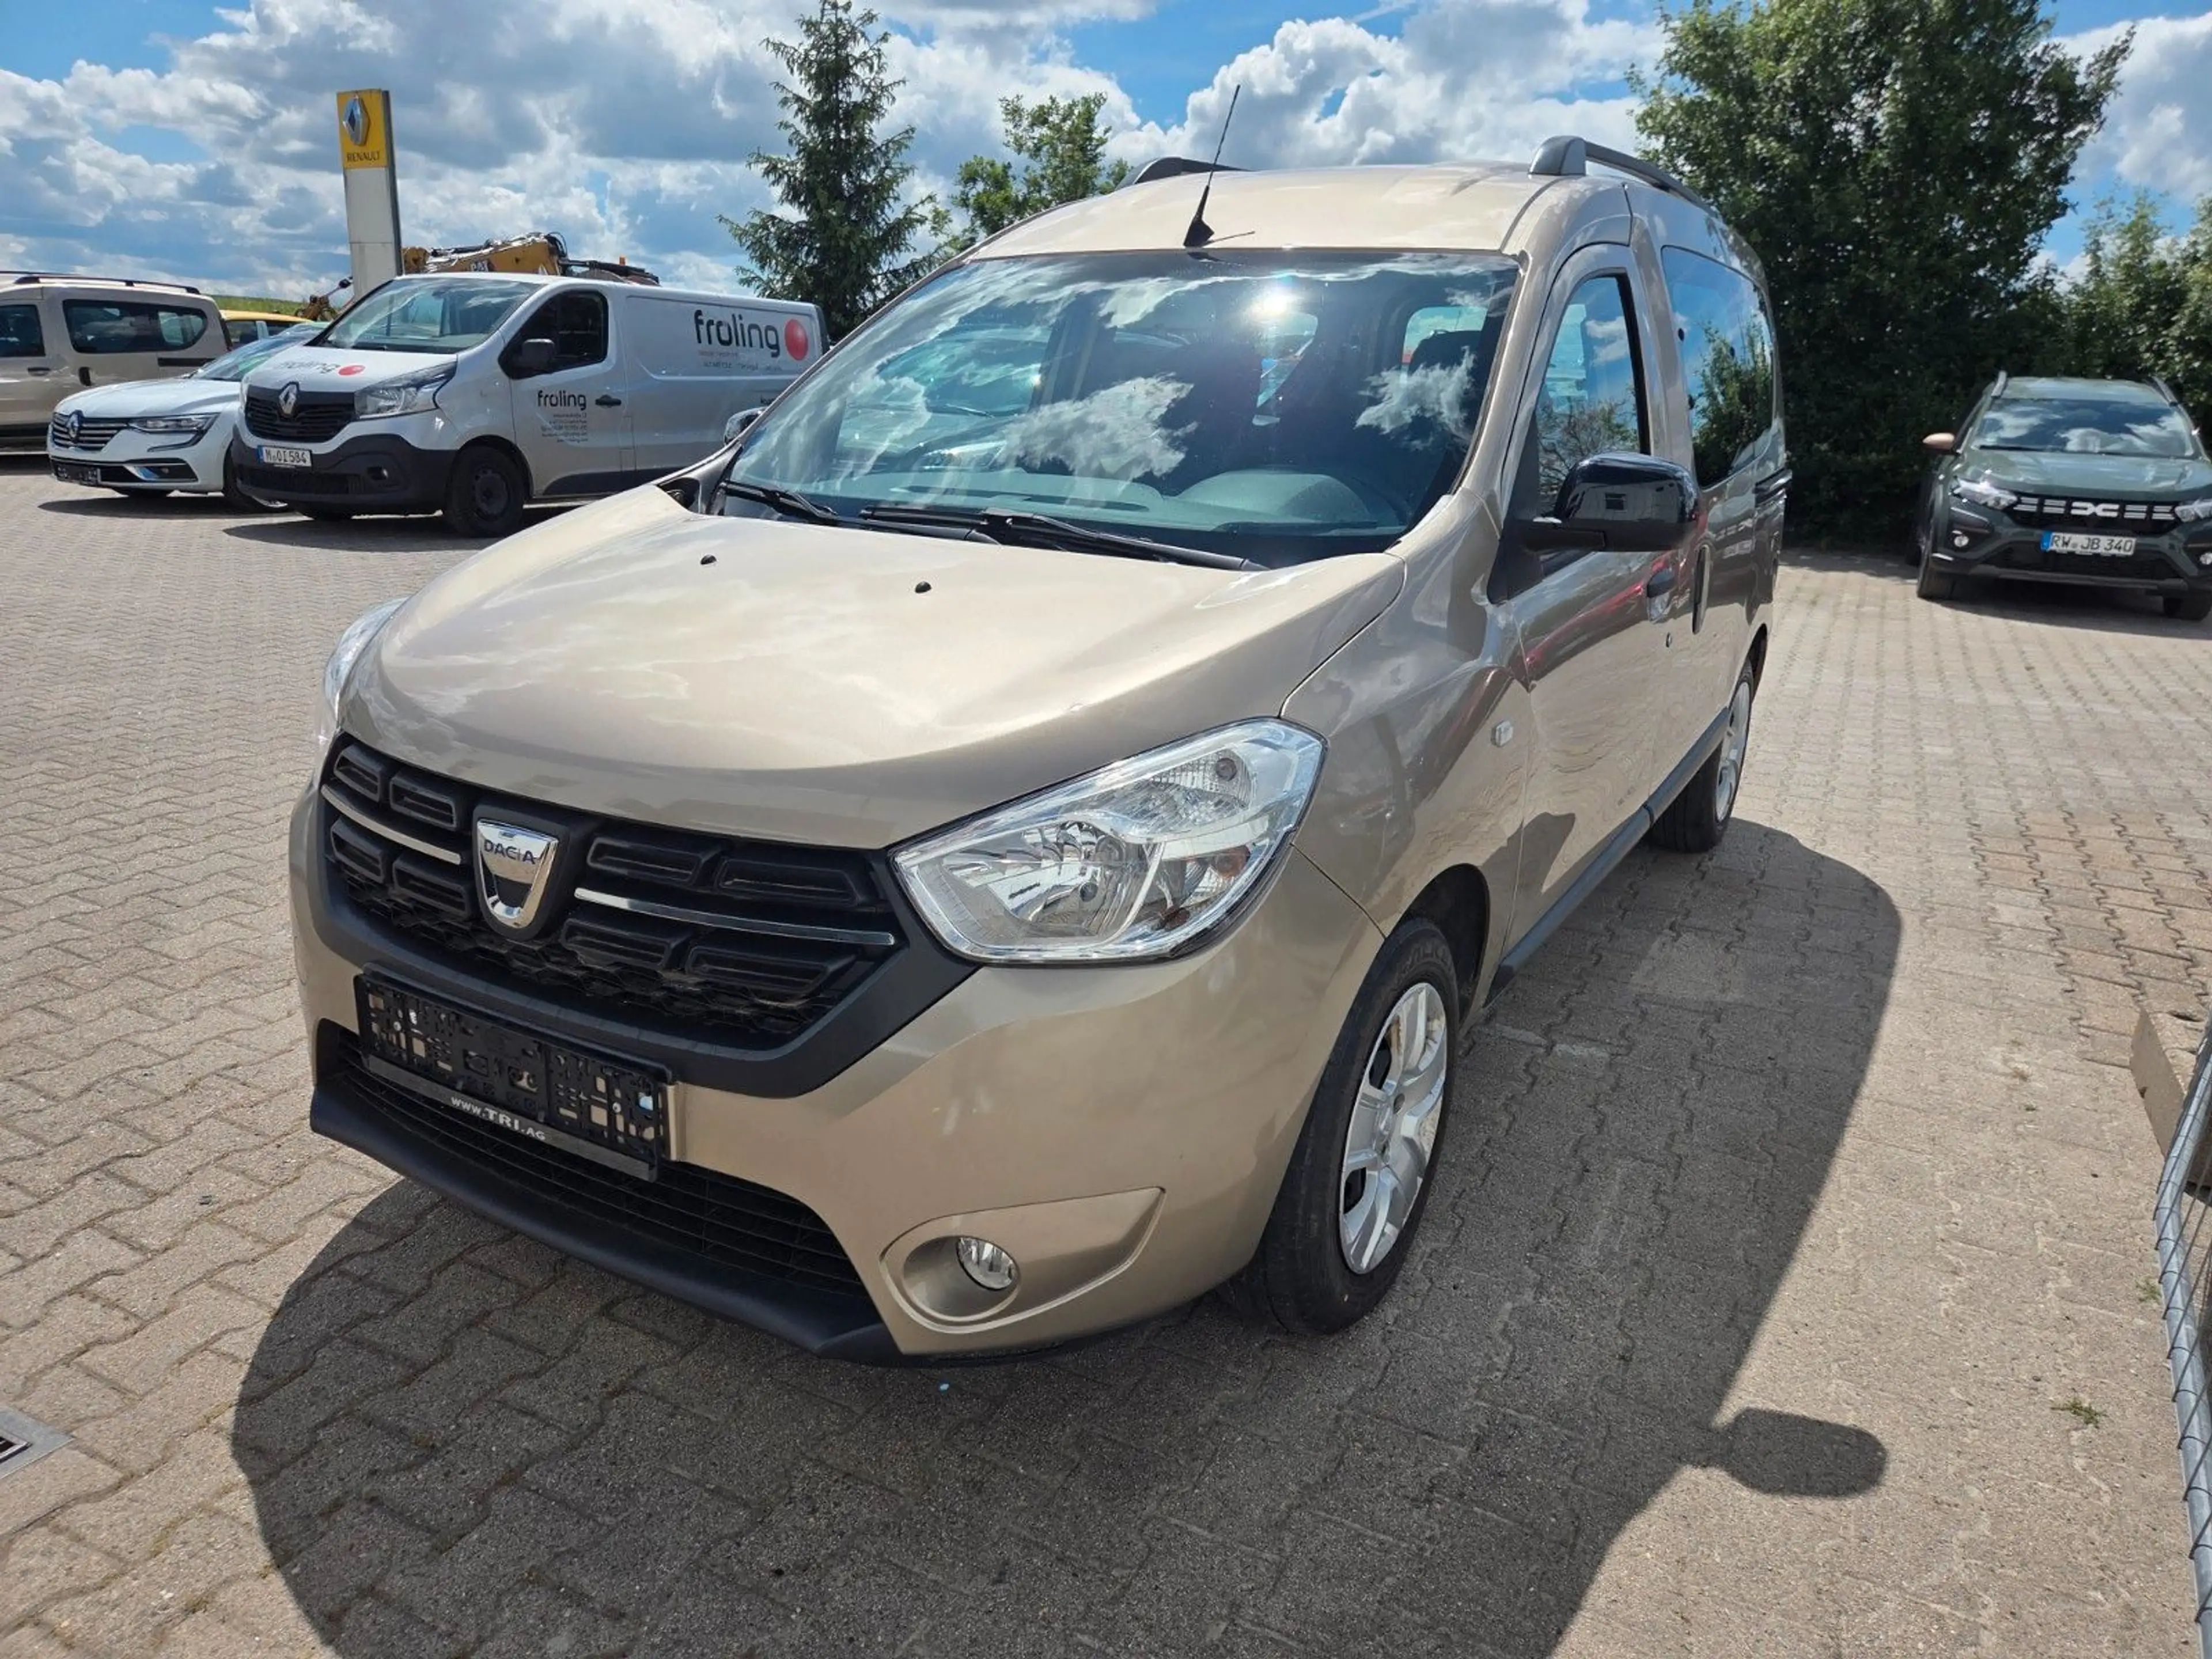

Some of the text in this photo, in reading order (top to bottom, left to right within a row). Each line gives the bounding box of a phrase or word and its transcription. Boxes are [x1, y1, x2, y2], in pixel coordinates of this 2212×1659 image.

[347, 151, 380, 162] RENAULT
[694, 309, 781, 358] froling
[537, 389, 586, 411] froling
[2051, 535, 2133, 552] RW JB 340
[484, 839, 536, 865] DACIA
